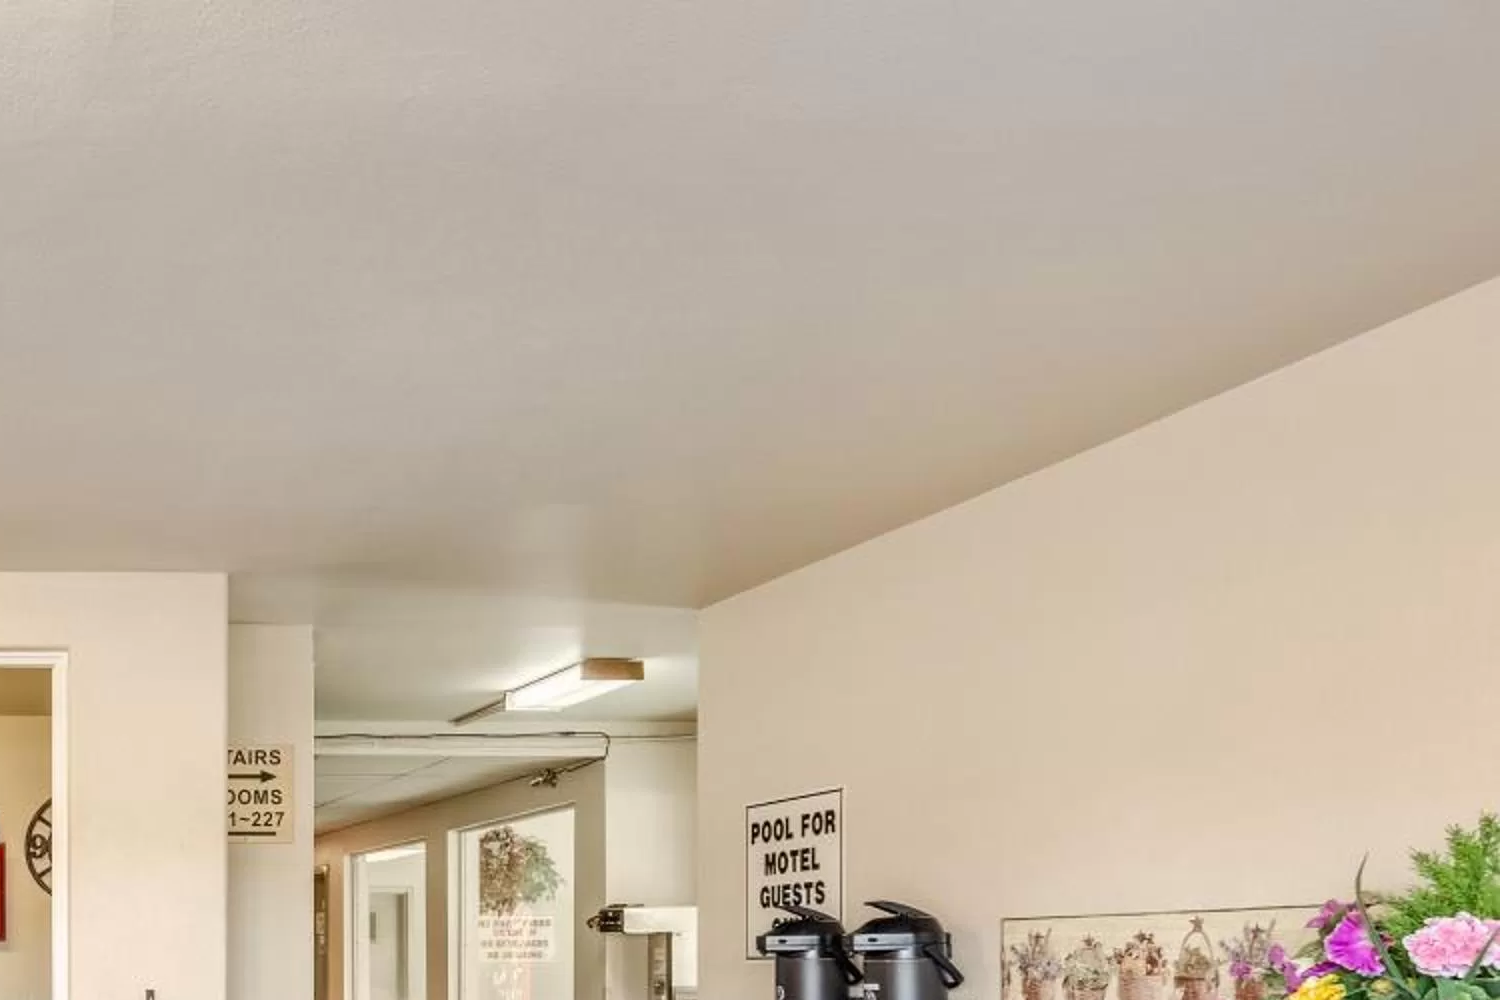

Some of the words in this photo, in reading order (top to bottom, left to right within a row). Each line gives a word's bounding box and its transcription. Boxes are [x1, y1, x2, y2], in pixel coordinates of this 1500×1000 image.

[751, 816, 794, 845] POOL
[800, 809, 836, 838] FOR
[763, 847, 820, 876] MOTEL
[760, 880, 826, 909] GUESTS
